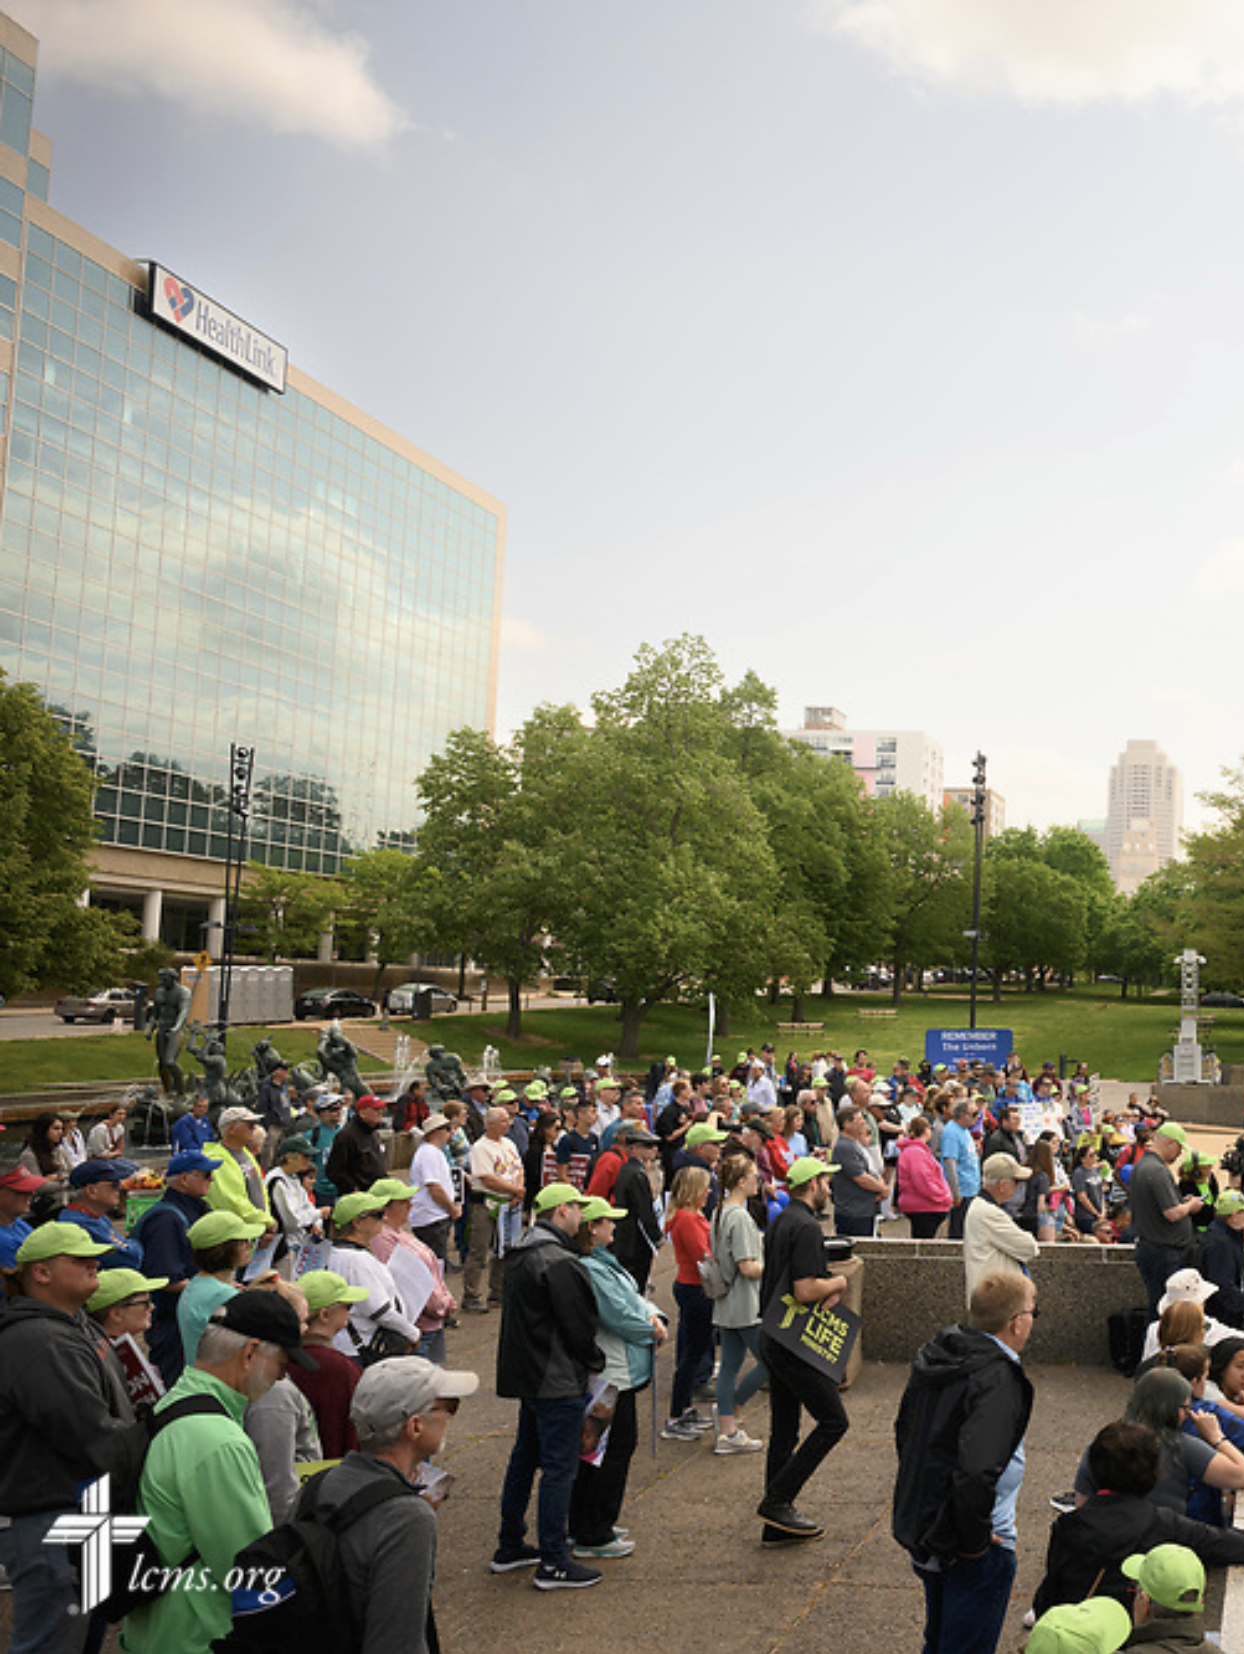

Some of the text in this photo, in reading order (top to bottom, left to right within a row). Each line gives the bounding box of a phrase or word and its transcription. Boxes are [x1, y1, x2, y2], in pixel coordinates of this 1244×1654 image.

[195, 299, 276, 377] HealthLink
[941, 1031, 997, 1041] REMEMBER
[943, 1042, 997, 1051] The Unborn
[804, 1316, 844, 1356] LIFE
[812, 1302, 850, 1337] LCMS
